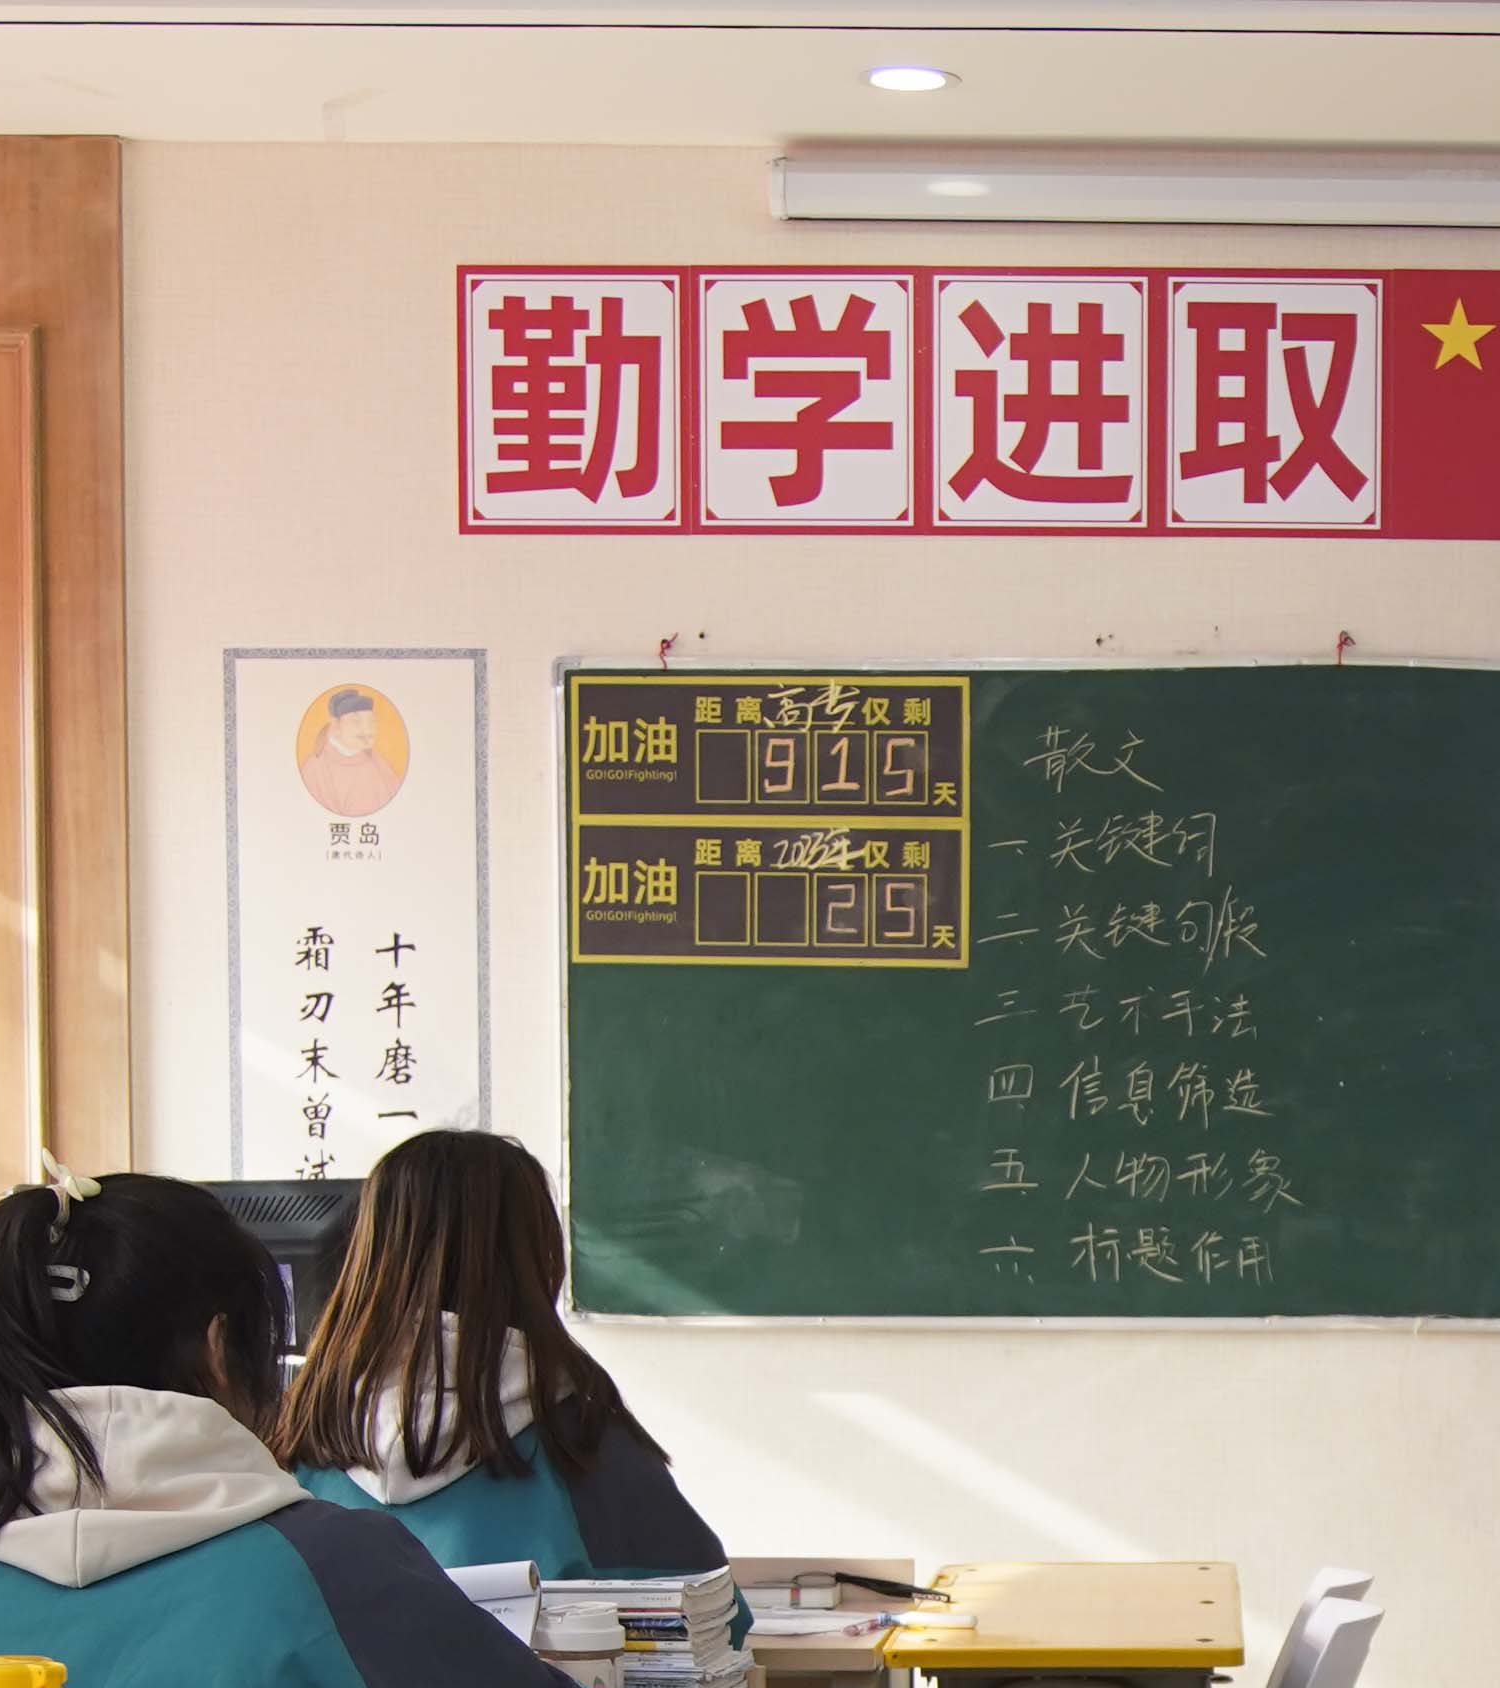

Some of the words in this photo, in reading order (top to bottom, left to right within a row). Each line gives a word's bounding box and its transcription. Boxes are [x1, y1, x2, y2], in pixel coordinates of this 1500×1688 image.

[484, 292, 1368, 508] 勤学进取
[582, 717, 678, 764] 加油
[1024, 726, 1164, 792] 散文
[933, 783, 957, 806] 天
[329, 821, 380, 846] 贾岛
[582, 858, 678, 905] 加油
[932, 925, 956, 948] 天
[374, 931, 418, 1120] 十年磨一
